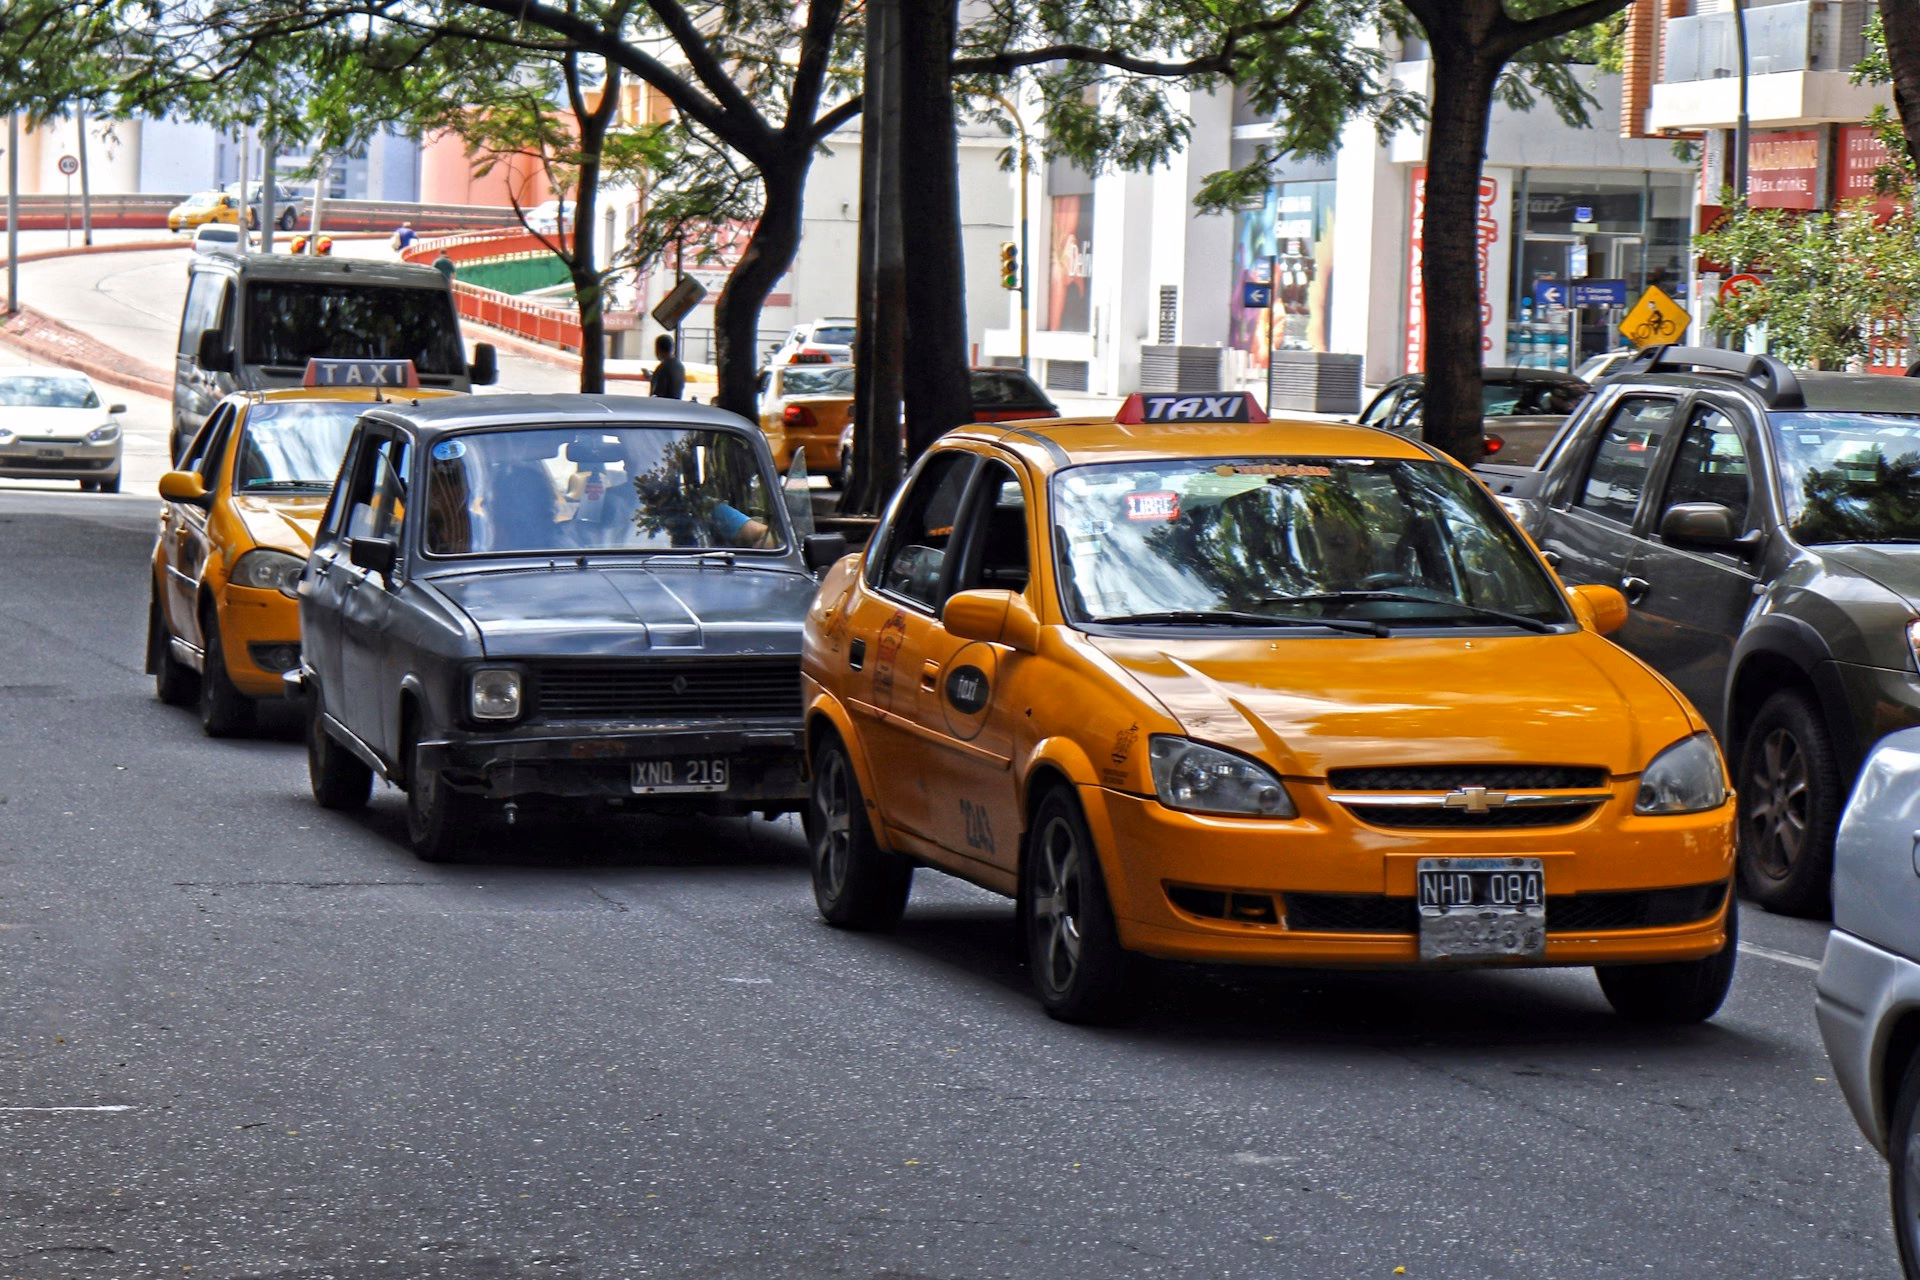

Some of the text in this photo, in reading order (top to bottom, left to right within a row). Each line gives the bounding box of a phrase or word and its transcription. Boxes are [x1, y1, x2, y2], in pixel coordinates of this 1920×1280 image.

[322, 364, 404, 384] TAXI
[1147, 396, 1244, 420] TAXI
[687, 760, 725, 784] 216
[1424, 873, 1538, 904] NHD 084
